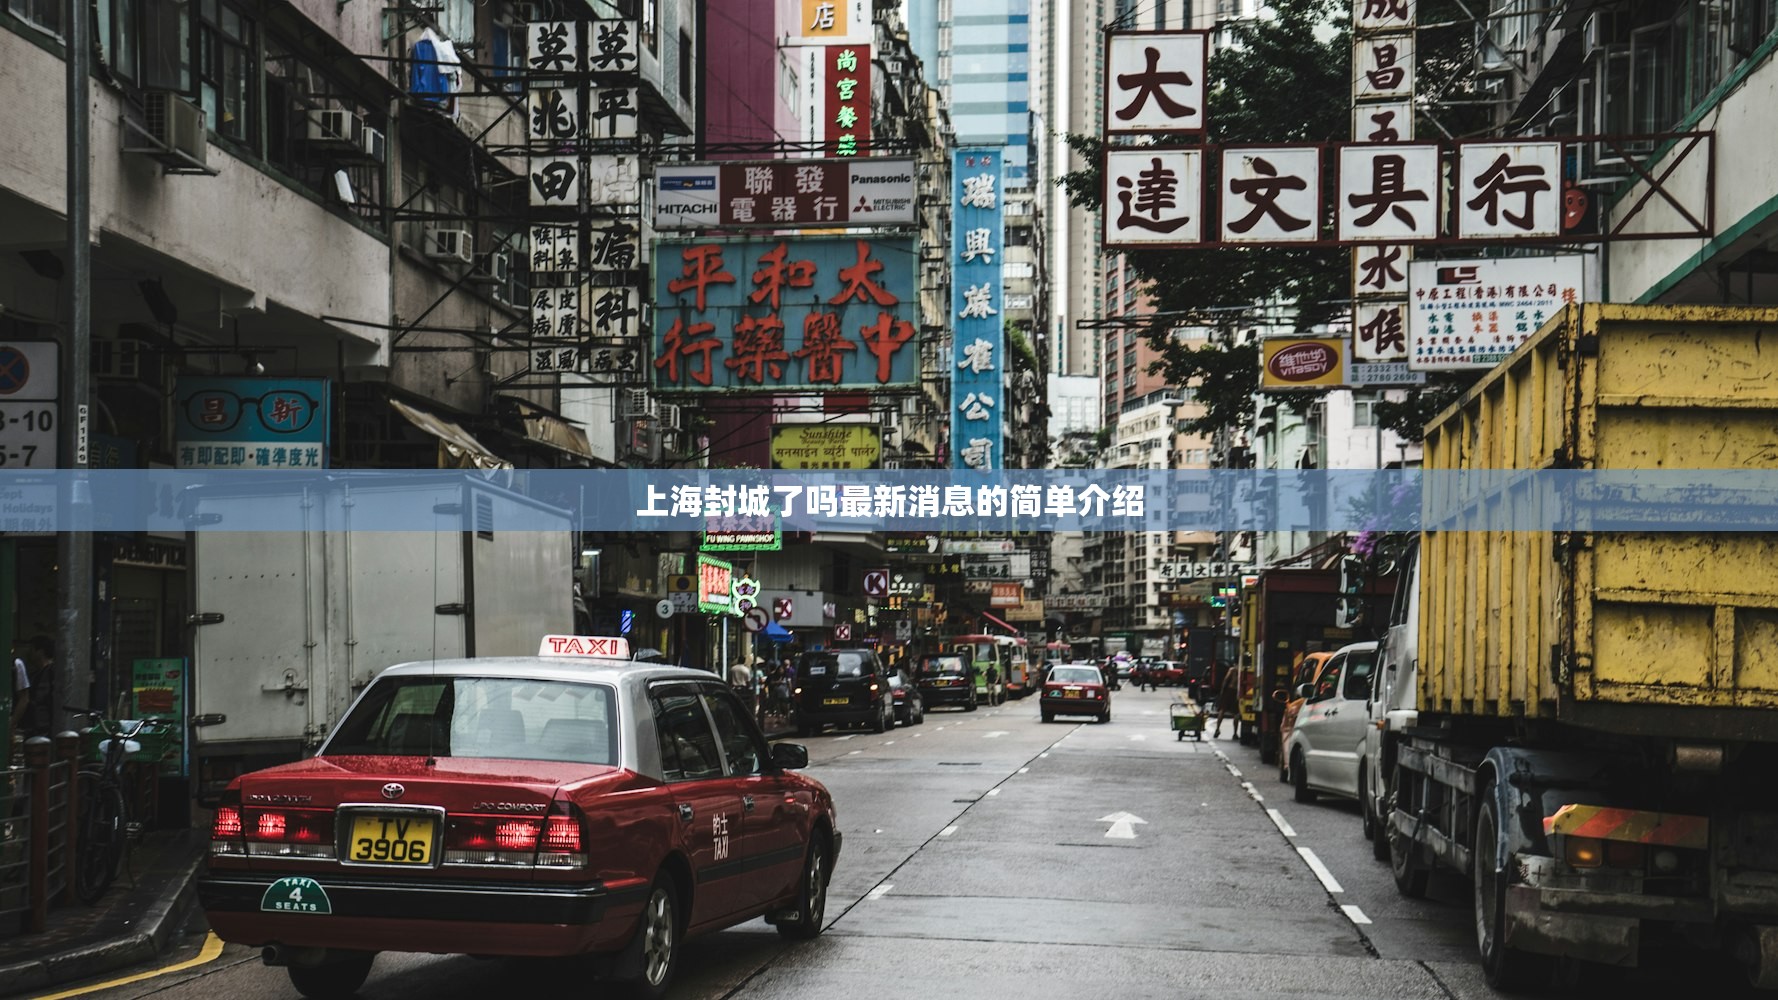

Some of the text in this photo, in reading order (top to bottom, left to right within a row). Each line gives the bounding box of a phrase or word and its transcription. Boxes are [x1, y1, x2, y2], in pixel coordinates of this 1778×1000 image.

[811, 3, 834, 31] 店
[1115, 47, 1197, 121] 大
[745, 166, 825, 195] 聯發
[851, 173, 911, 184] Panasonic
[1116, 153, 1552, 235] 達文具行
[658, 204, 717, 214] HITACHI
[730, 196, 838, 222] 電器行
[0, 410, 53, 432] -10
[799, 427, 852, 440] Sunshine
[0, 445, 37, 467] -7
[736, 534, 775, 543] PAWNSHOP
[661, 604, 669, 614] 3
[548, 637, 619, 655] TAXI
[497, 802, 547, 812] COMFORT
[378, 818, 412, 841] TV
[713, 812, 728, 835] 的士
[356, 837, 427, 862] 3906
[713, 836, 728, 861] TAXI
[283, 877, 312, 889] TAXI
[289, 886, 303, 902] 4
[275, 902, 317, 912] SEATS
